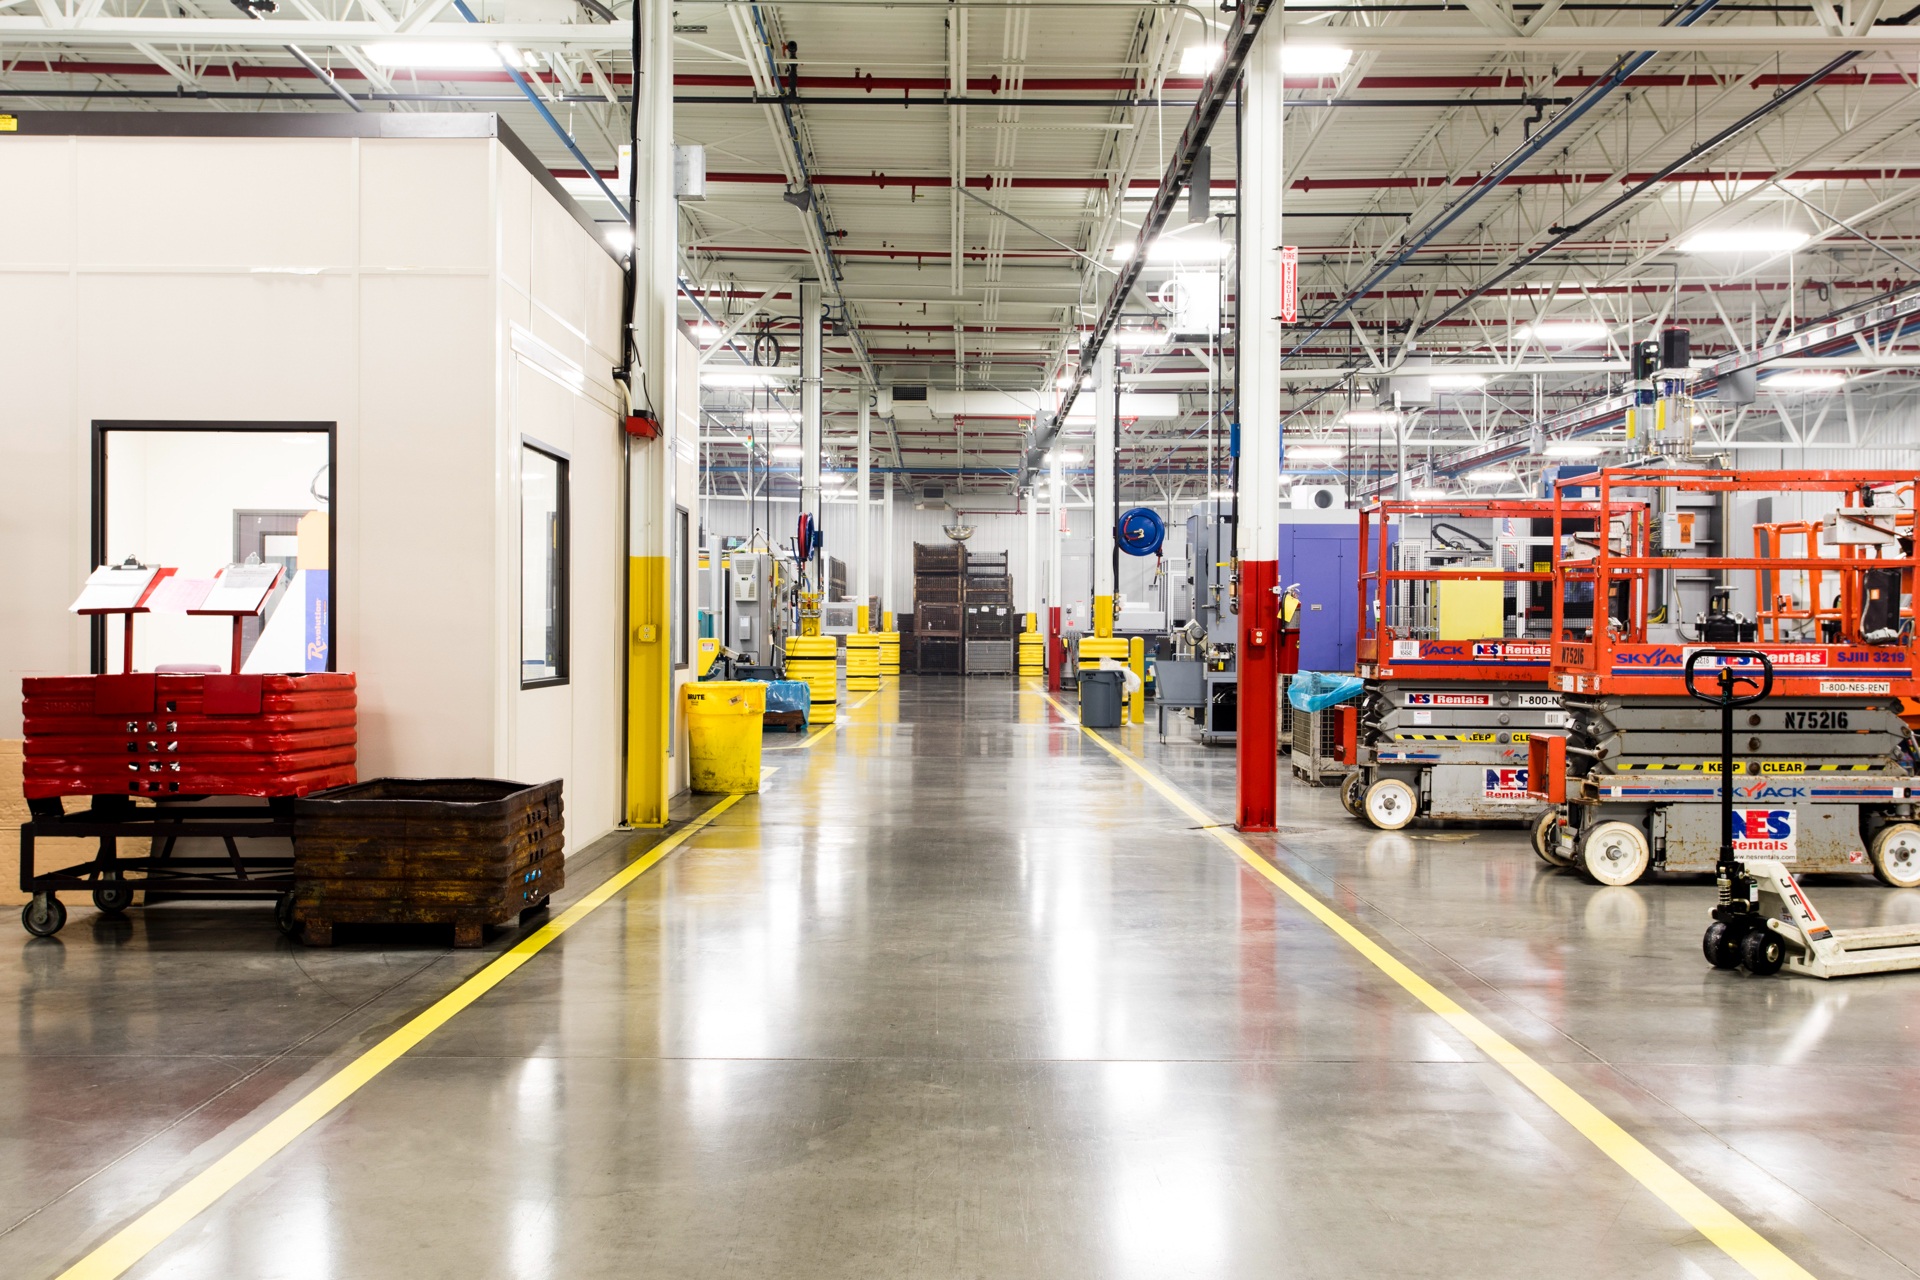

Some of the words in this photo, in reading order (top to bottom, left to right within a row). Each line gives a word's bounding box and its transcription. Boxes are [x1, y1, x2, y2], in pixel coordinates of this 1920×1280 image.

[1283, 252, 1295, 260] FIRE
[307, 598, 327, 660] Revolution
[1477, 645, 1498, 655] NES
[1505, 646, 1551, 655] Rentals
[1561, 647, 1584, 665] N75216
[1837, 652, 1869, 662] SJIII
[1873, 652, 1905, 662] 3219
[1821, 683, 1889, 692] 1-800-NES-RENT
[1409, 694, 1430, 704] NES
[1437, 695, 1484, 704] Rentals
[1785, 711, 1848, 729] N75216
[1708, 763, 1740, 772] KEP
[1763, 763, 1802, 772] CLEAR
[1486, 769, 1528, 790] NES
[1732, 810, 1791, 840] NES
[1780, 878, 1813, 921] JET
